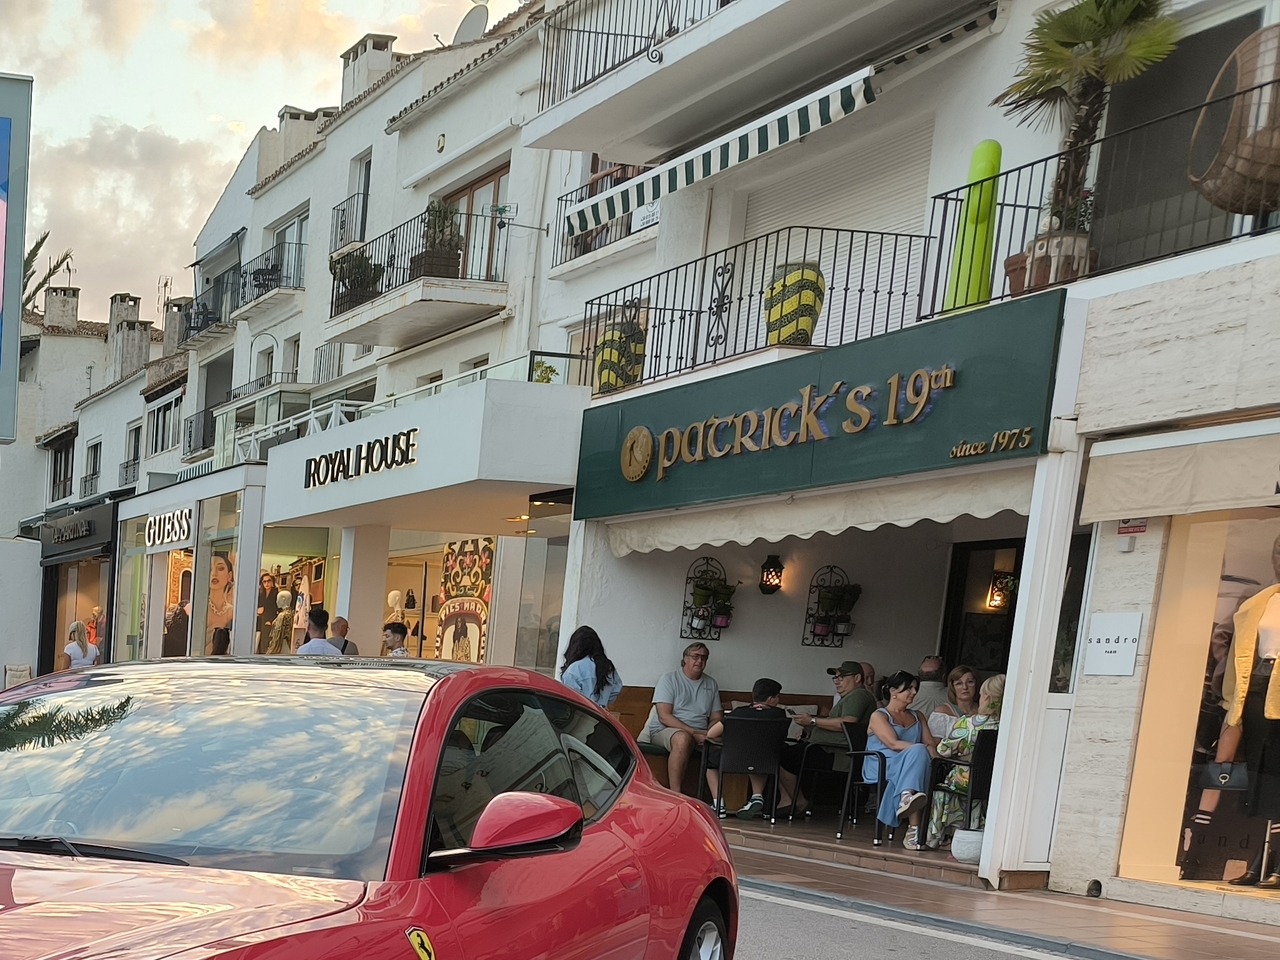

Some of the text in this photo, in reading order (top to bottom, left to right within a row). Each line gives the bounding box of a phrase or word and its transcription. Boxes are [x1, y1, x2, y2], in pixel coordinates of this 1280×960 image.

[883, 363, 955, 427] 19th
[949, 426, 1033, 459] since 1975
[145, 508, 191, 547] GUESS
[1088, 635, 1138, 645] sandro
